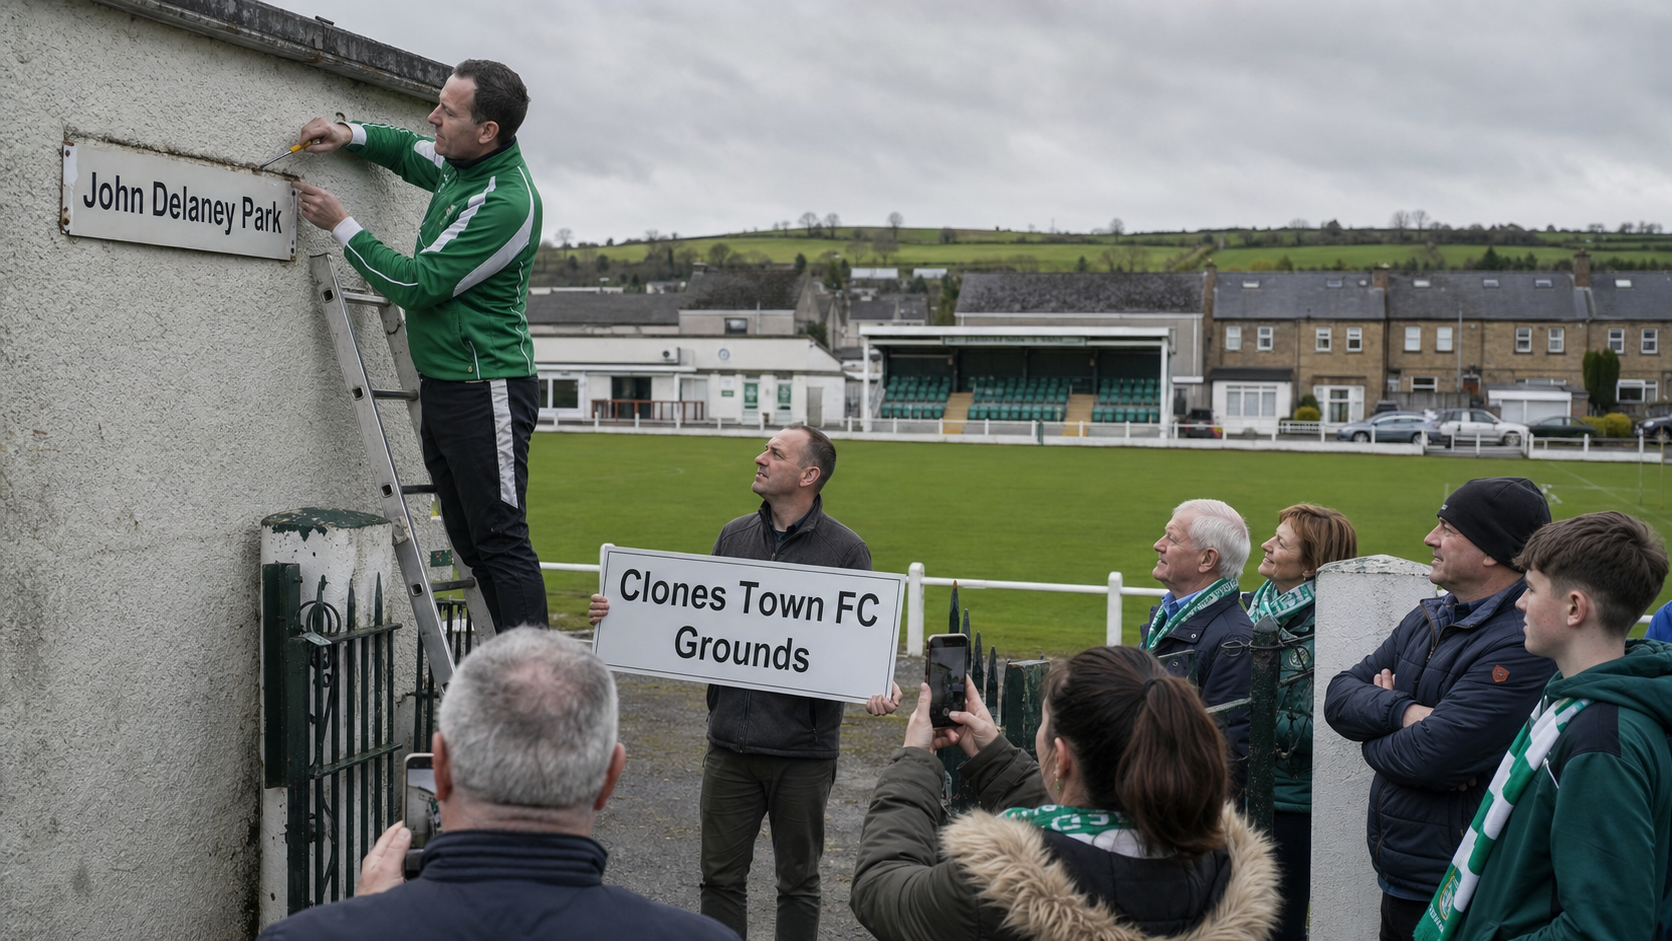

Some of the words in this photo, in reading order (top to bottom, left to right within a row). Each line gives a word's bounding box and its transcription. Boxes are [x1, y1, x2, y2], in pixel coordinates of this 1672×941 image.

[82, 171, 144, 215] John
[152, 180, 236, 236] Delaney
[241, 195, 283, 234] Park
[620, 568, 727, 612] Clones
[739, 580, 825, 622] Town
[835, 590, 881, 628] FC
[674, 625, 810, 674] Grounds
